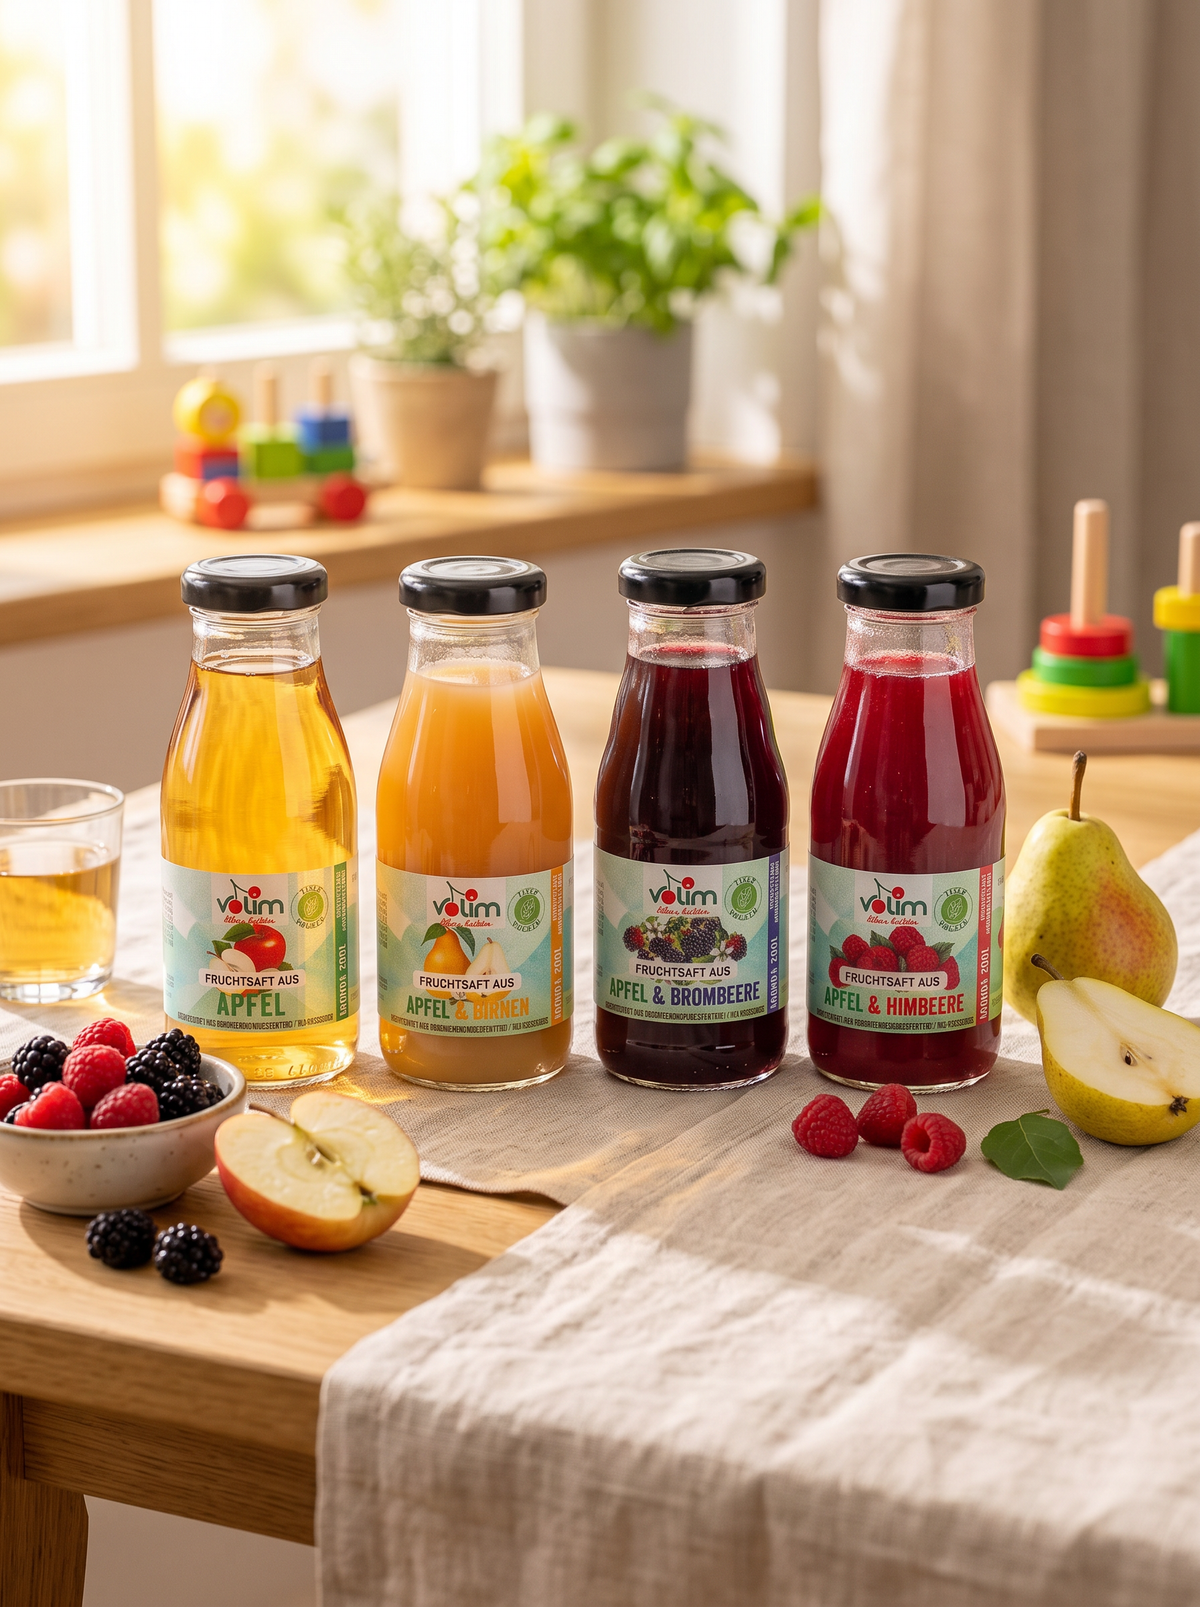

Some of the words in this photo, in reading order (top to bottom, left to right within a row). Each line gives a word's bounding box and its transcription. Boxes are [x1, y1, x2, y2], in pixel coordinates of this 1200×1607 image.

[205, 973, 275, 987] FRUCHTSAFT
[278, 974, 300, 985] AUS
[635, 964, 706, 978] FRUCHTSAFT
[709, 966, 731, 977] AUS
[845, 971, 915, 987] FRUCHTSAFT
[917, 976, 940, 987] AUS
[419, 976, 490, 989] FRUCHTSAFT
[493, 977, 515, 988] AUS
[609, 977, 648, 1003] APFEL
[652, 985, 666, 1005] &
[670, 981, 760, 1006] BROMBEERE
[216, 992, 286, 1017] APFEL
[406, 995, 450, 1020] APFEL
[455, 1000, 469, 1020] &
[473, 997, 530, 1021] BIRNEN
[824, 986, 863, 1013] APFEL
[868, 995, 881, 1015] &
[886, 993, 964, 1016] HIMBEERE
